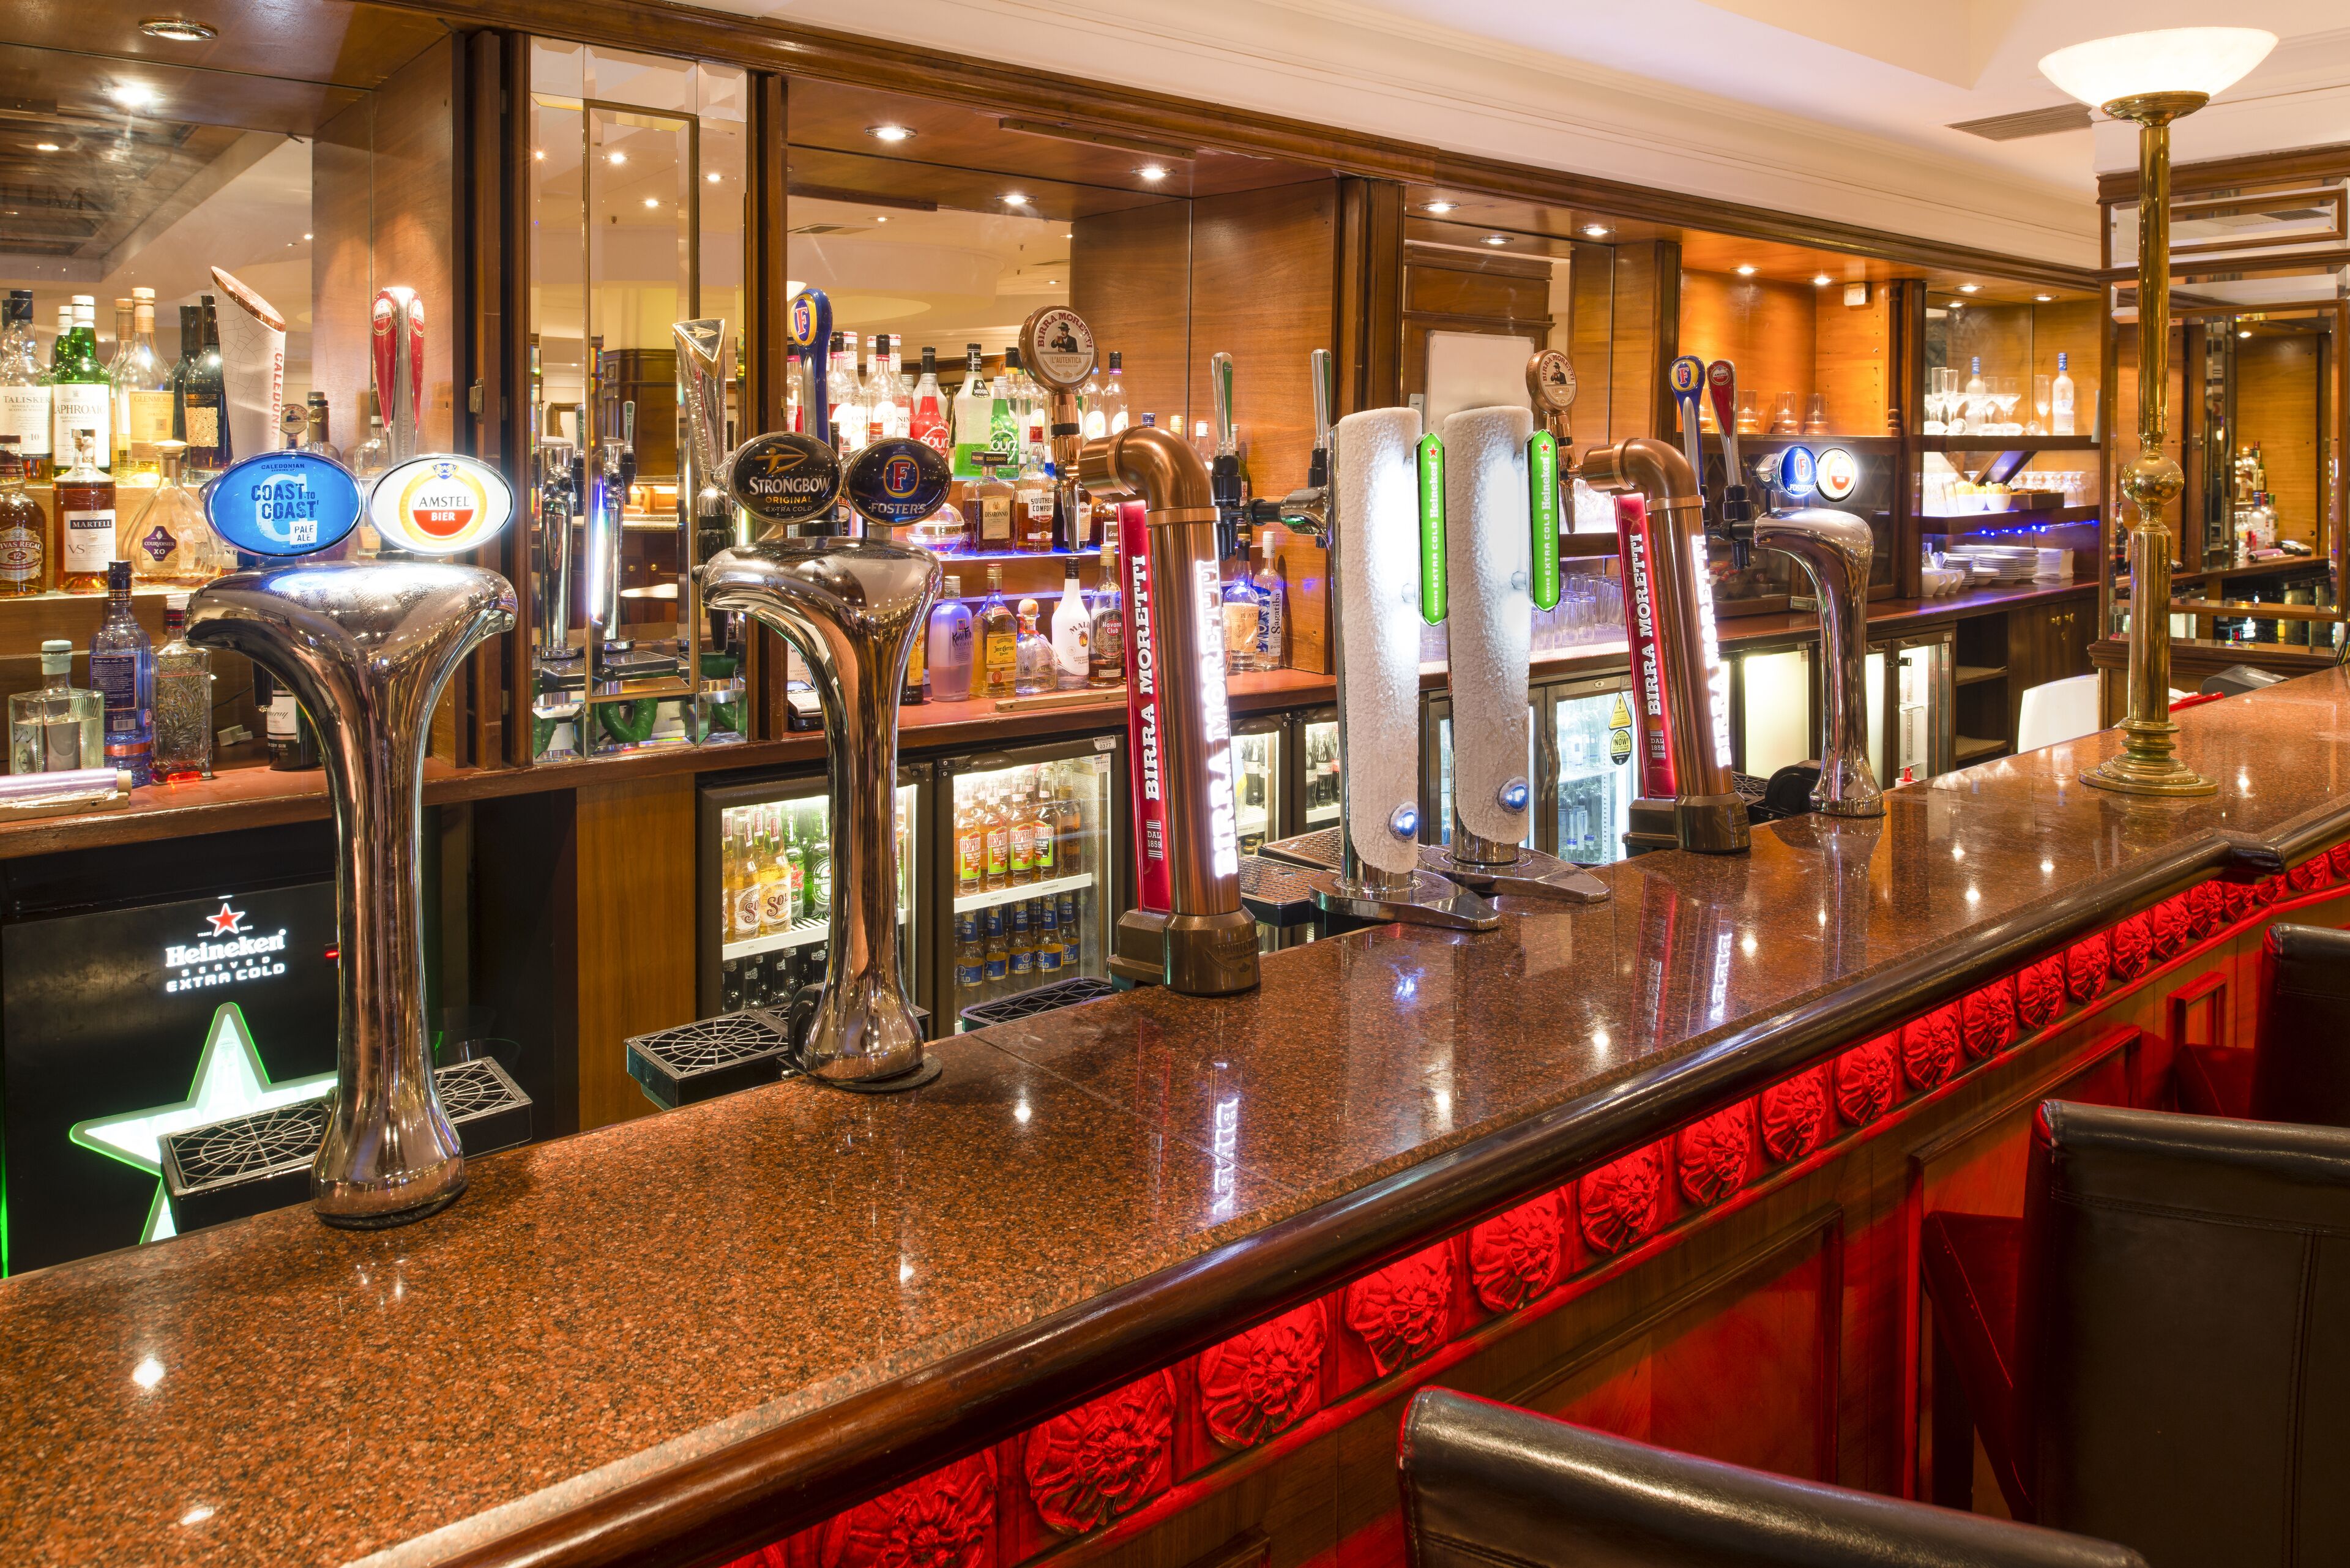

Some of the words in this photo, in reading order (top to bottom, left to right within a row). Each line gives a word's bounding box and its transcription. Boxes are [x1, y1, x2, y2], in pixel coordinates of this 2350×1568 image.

[796, 307, 808, 335] F
[1037, 315, 1058, 348] BIRRA
[1058, 312, 1093, 348] MORETTI
[1542, 357, 1553, 382] BIRRA
[1552, 354, 1576, 381] MORETTI
[1678, 367, 1689, 384] F
[892, 462, 910, 491] F
[1798, 457, 1806, 476] F
[251, 483, 305, 501] COAST
[749, 477, 832, 495] STRONGBOW
[1428, 461, 1438, 519] Heineken
[1540, 456, 1551, 510] Heineken
[419, 496, 469, 507] AMSTEL
[870, 503, 926, 514] FOSTER'S
[294, 525, 314, 534] PALE
[431, 512, 456, 521] BIER
[20, 541, 41, 550] REGAL
[68, 544, 85, 554] VS
[1629, 533, 1654, 638] MORETTI
[1132, 554, 1154, 695] MORETTI
[1270, 592, 1281, 635] Sagatiba
[1195, 559, 1228, 743] MORETTI
[1642, 643, 1662, 716] BIRRA
[1141, 703, 1160, 801] BIRRA
[1207, 748, 1239, 878] BIRRA
[1147, 840, 1162, 848] 1859
[766, 892, 788, 917] SOL
[165, 928, 286, 967] Heineken
[166, 972, 231, 992] EXTRA
[236, 963, 285, 980] COLD
[181, 956, 270, 977] SERVED
